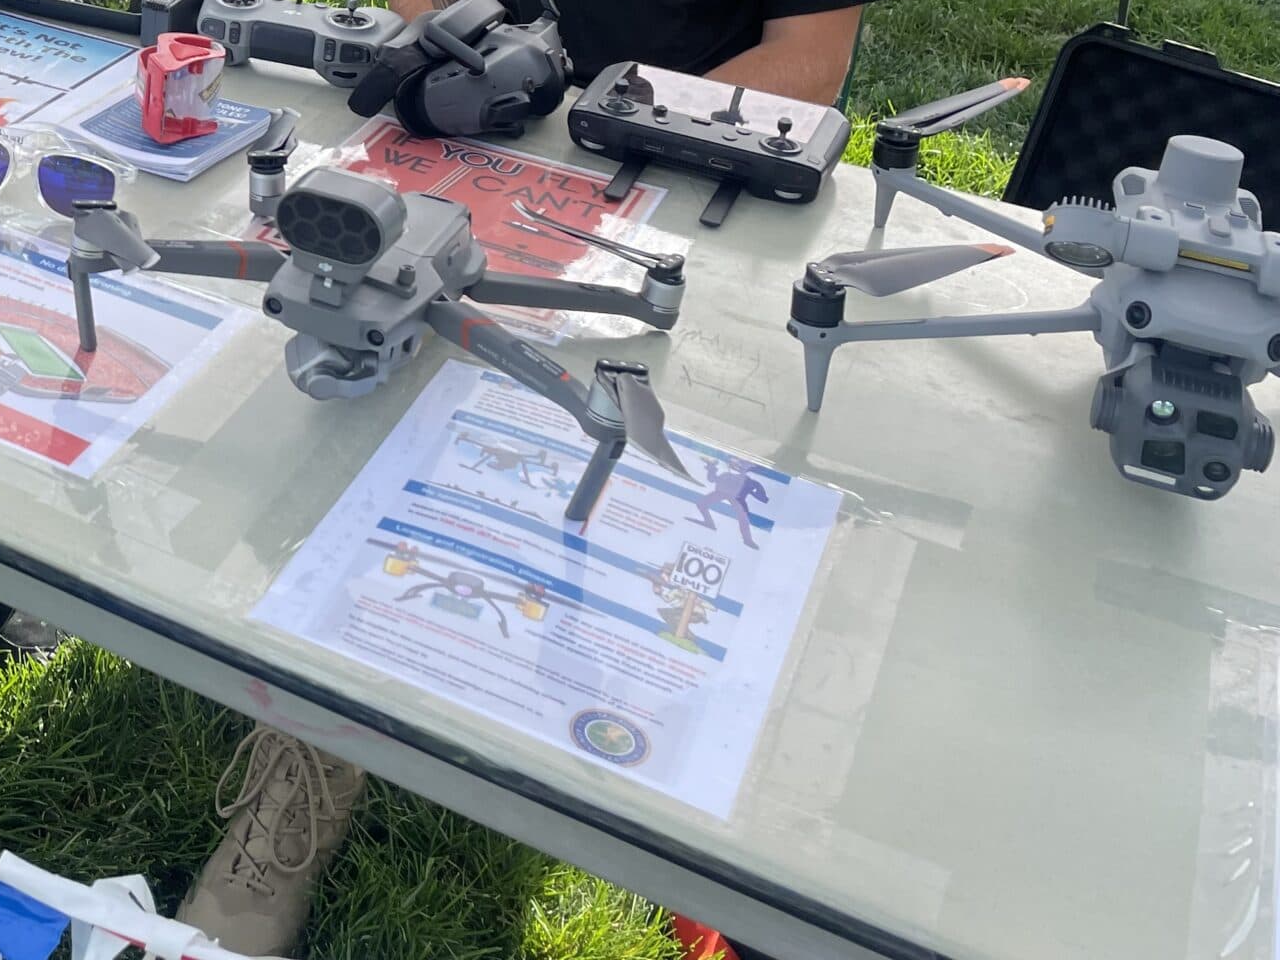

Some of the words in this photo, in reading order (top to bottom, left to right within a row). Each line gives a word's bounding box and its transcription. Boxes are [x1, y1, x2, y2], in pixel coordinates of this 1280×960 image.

[34, 33, 84, 50] Not
[41, 45, 88, 63] The
[440, 142, 523, 176] YOU
[536, 172, 608, 198] FLY
[383, 148, 439, 174] WE
[472, 175, 608, 218] CAN'T
[687, 544, 727, 566] DRONE
[676, 551, 723, 586] 100
[672, 574, 711, 594] LIMIT
